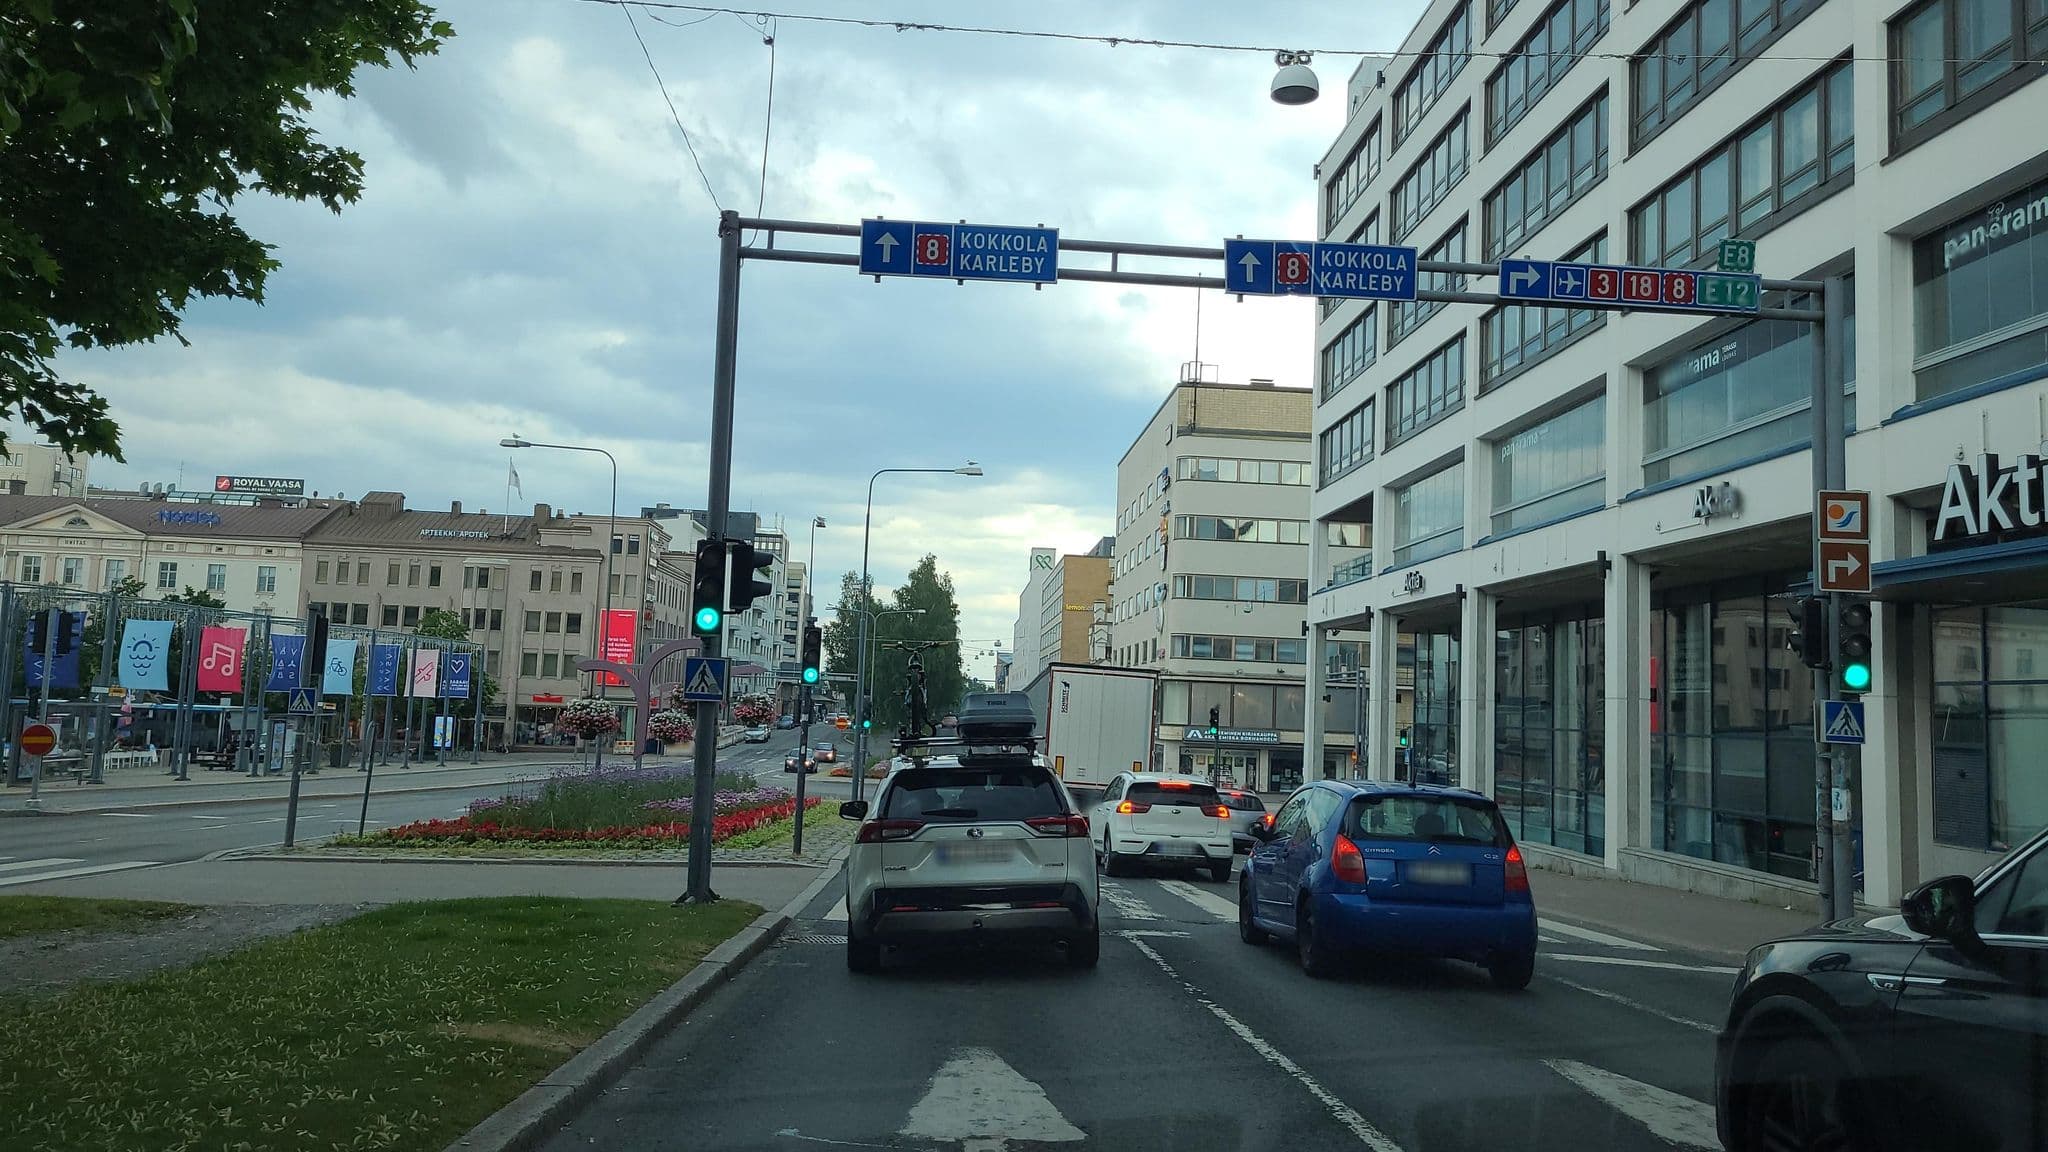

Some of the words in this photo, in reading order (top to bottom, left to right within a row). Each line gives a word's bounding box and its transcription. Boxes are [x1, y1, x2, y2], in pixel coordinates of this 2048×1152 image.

[925, 239, 940, 260] 8
[960, 232, 1048, 253] KOKKOLA
[959, 253, 1045, 274] KARLEBY
[1321, 250, 1407, 271] KOKKOLA
[1724, 244, 1749, 267] E8
[1286, 257, 1300, 280] 8
[1320, 271, 1404, 292] KARLEBY
[1597, 273, 1610, 295] 3
[1630, 275, 1652, 297] 18
[1672, 278, 1686, 299] 8
[233, 478, 266, 487] ROYAL
[268, 480, 302, 489] VAASA
[459, 530, 489, 539] APOTEK
[1483, 852, 1500, 860] C2
